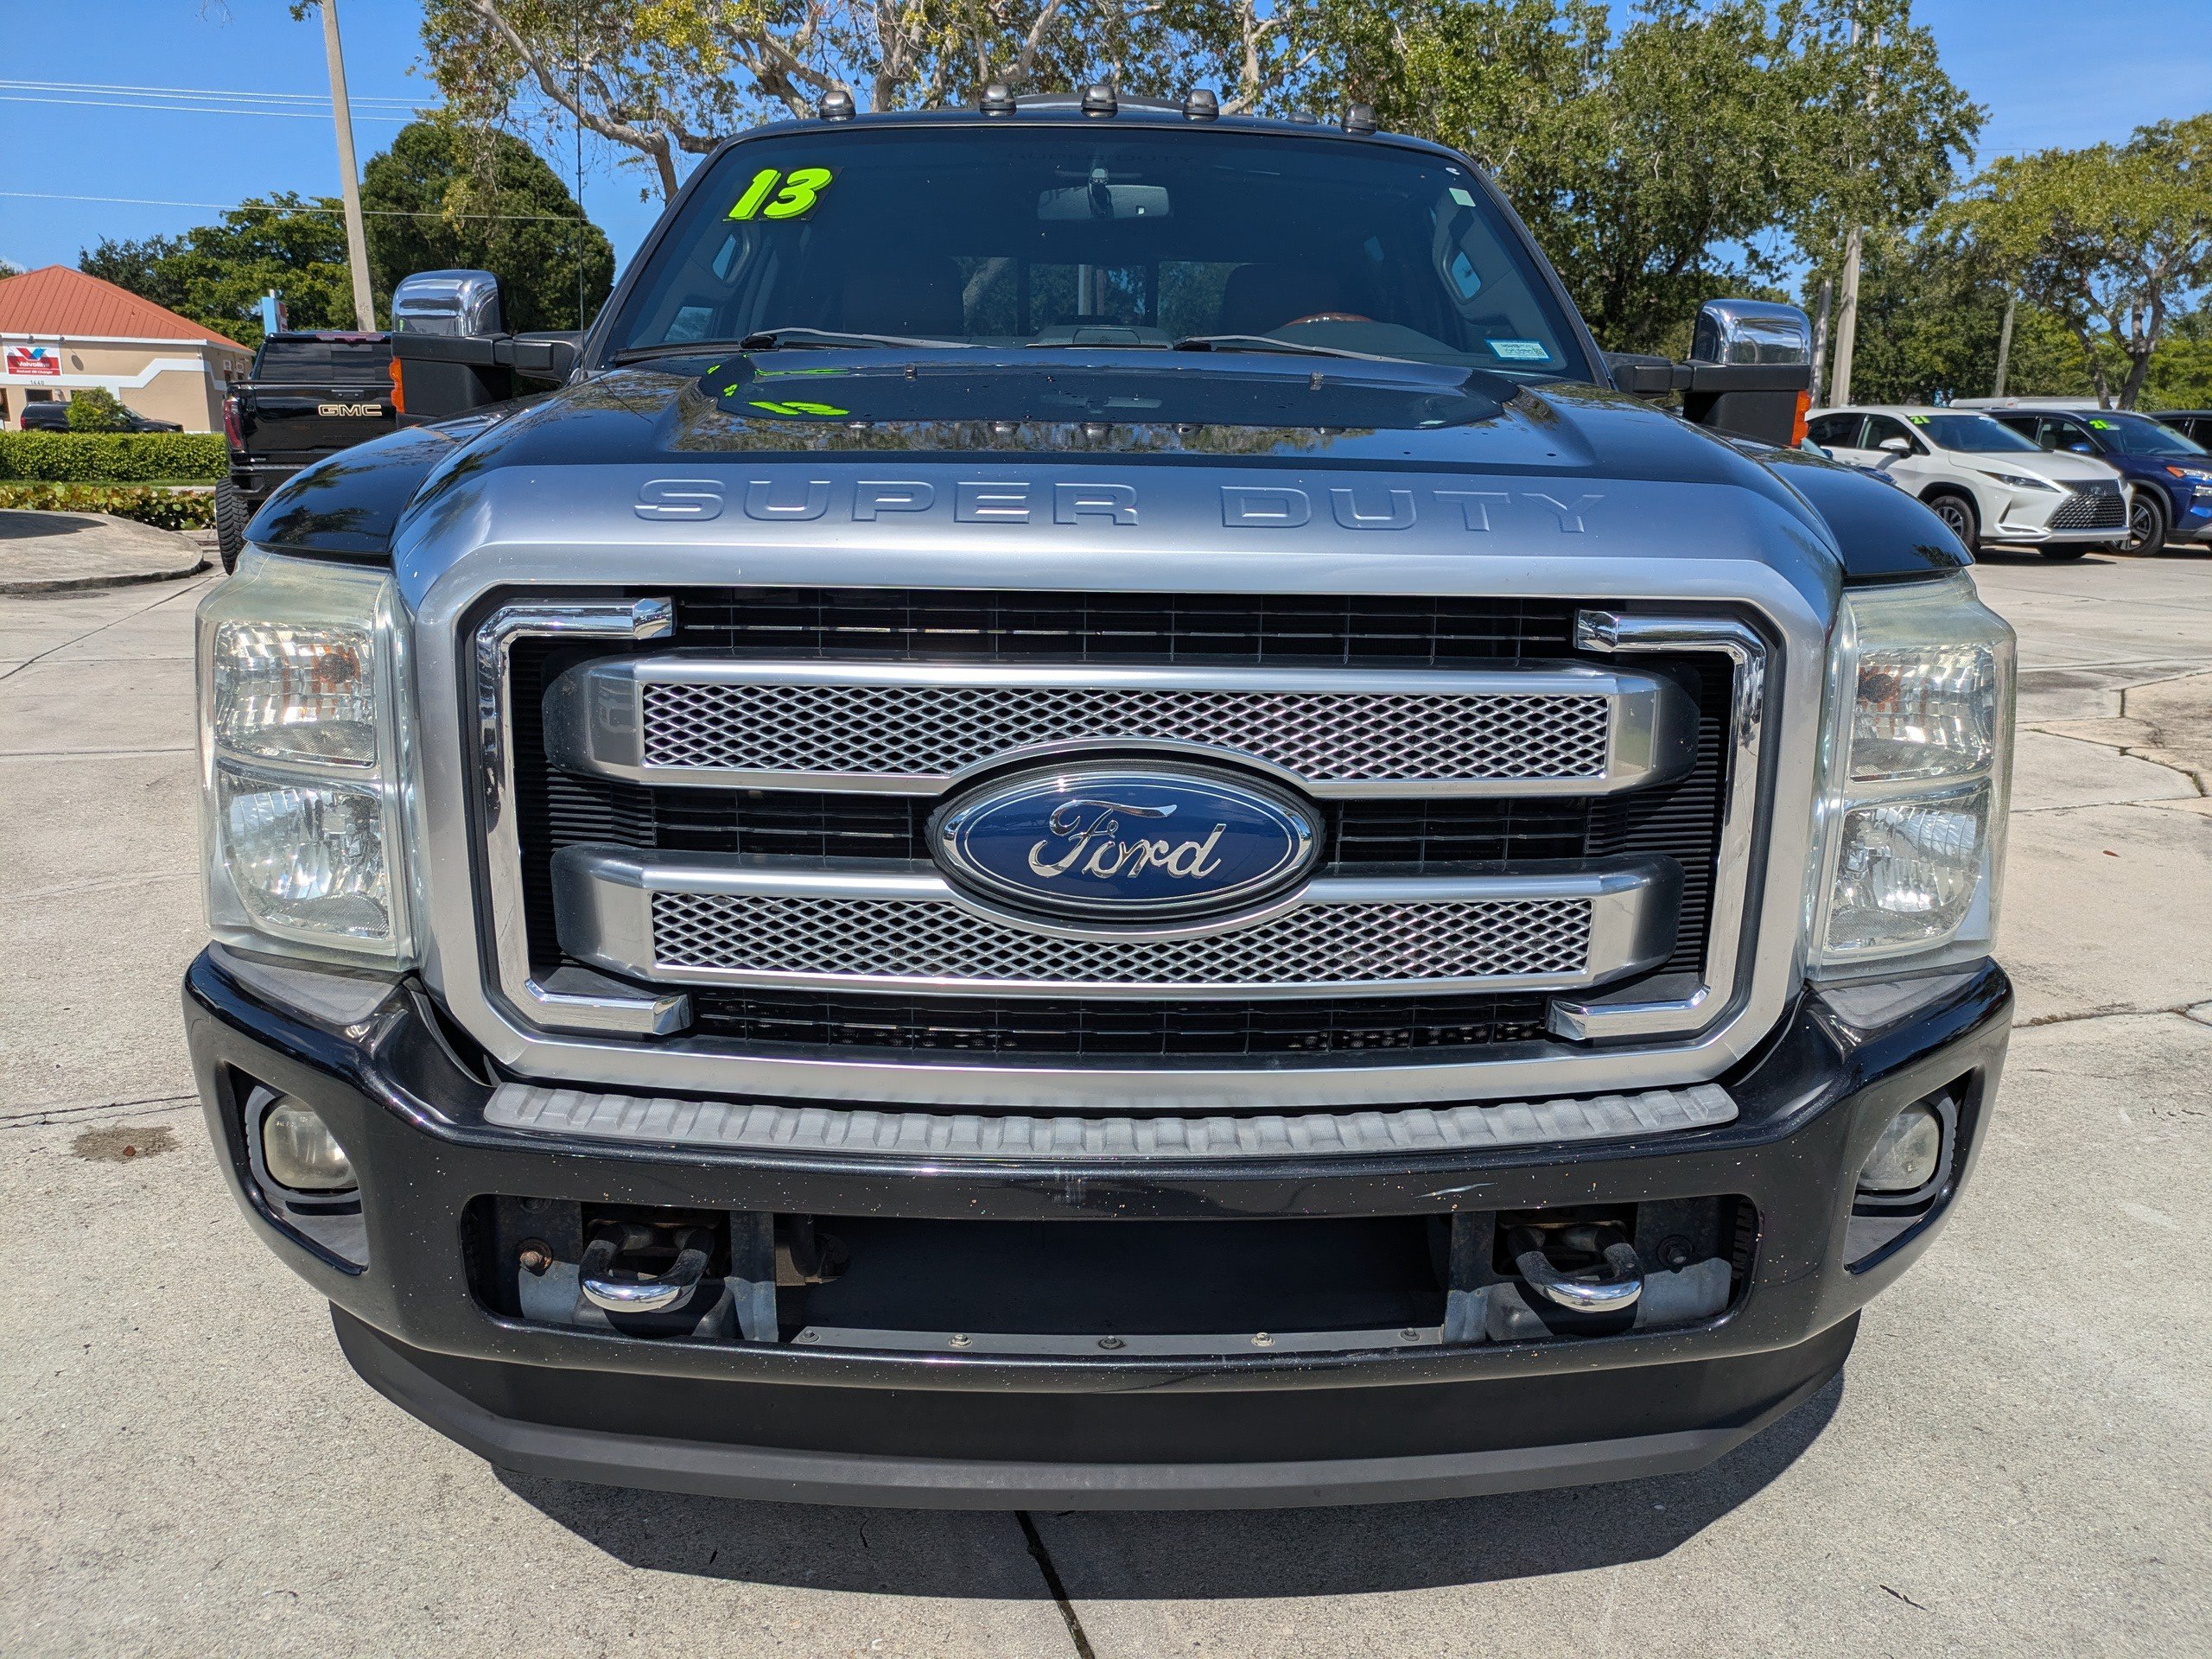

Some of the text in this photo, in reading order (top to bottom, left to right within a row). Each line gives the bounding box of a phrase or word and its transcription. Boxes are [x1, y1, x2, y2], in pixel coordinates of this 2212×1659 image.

[728, 168, 833, 220] 13
[318, 404, 383, 416] GMC
[633, 479, 1605, 534] SUPER DUTY
[1027, 798, 1226, 880] Ford
